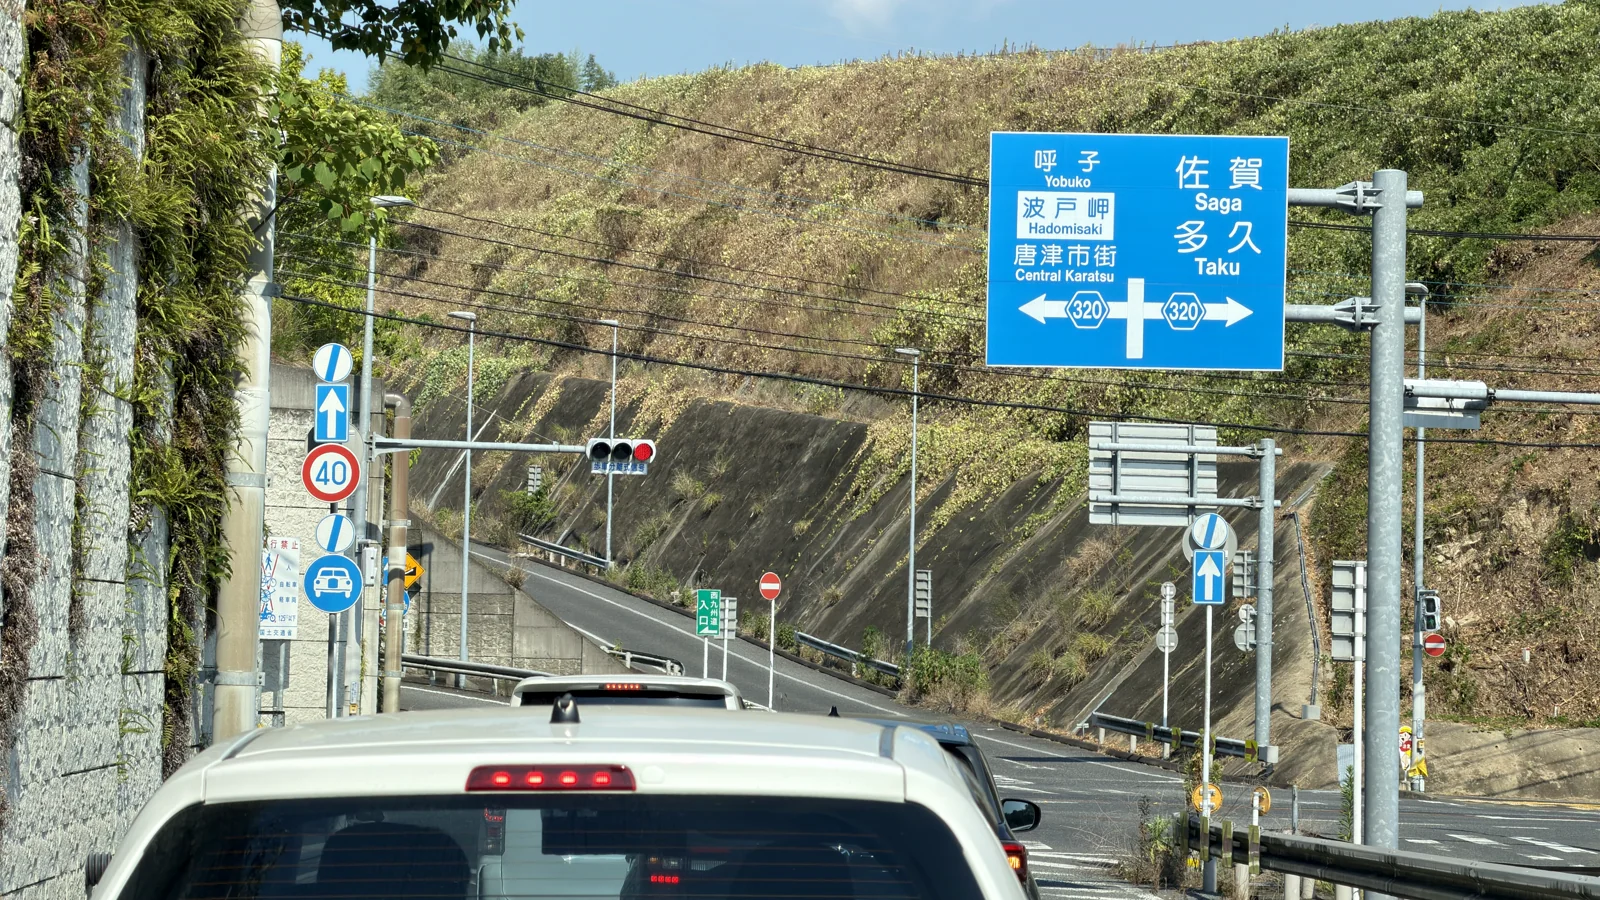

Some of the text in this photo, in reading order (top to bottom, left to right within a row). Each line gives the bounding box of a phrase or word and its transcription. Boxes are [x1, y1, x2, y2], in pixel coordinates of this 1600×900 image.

[1034, 149, 1100, 172] 呼子
[1044, 175, 1091, 188] Yobuko
[1175, 155, 1262, 190] 佐賀
[1022, 196, 1109, 220] 波戸岬
[1195, 192, 1242, 215] Saga
[1028, 222, 1103, 235] Hadomisaki
[1173, 220, 1261, 254] 多久
[1013, 243, 1117, 267] 唐津市街
[1194, 257, 1240, 276] Taku
[1015, 268, 1115, 283] Central Karatsu
[1072, 300, 1102, 320] 320
[1168, 301, 1199, 321] 320
[315, 460, 347, 486] 40
[698, 599, 709, 626] 入口
